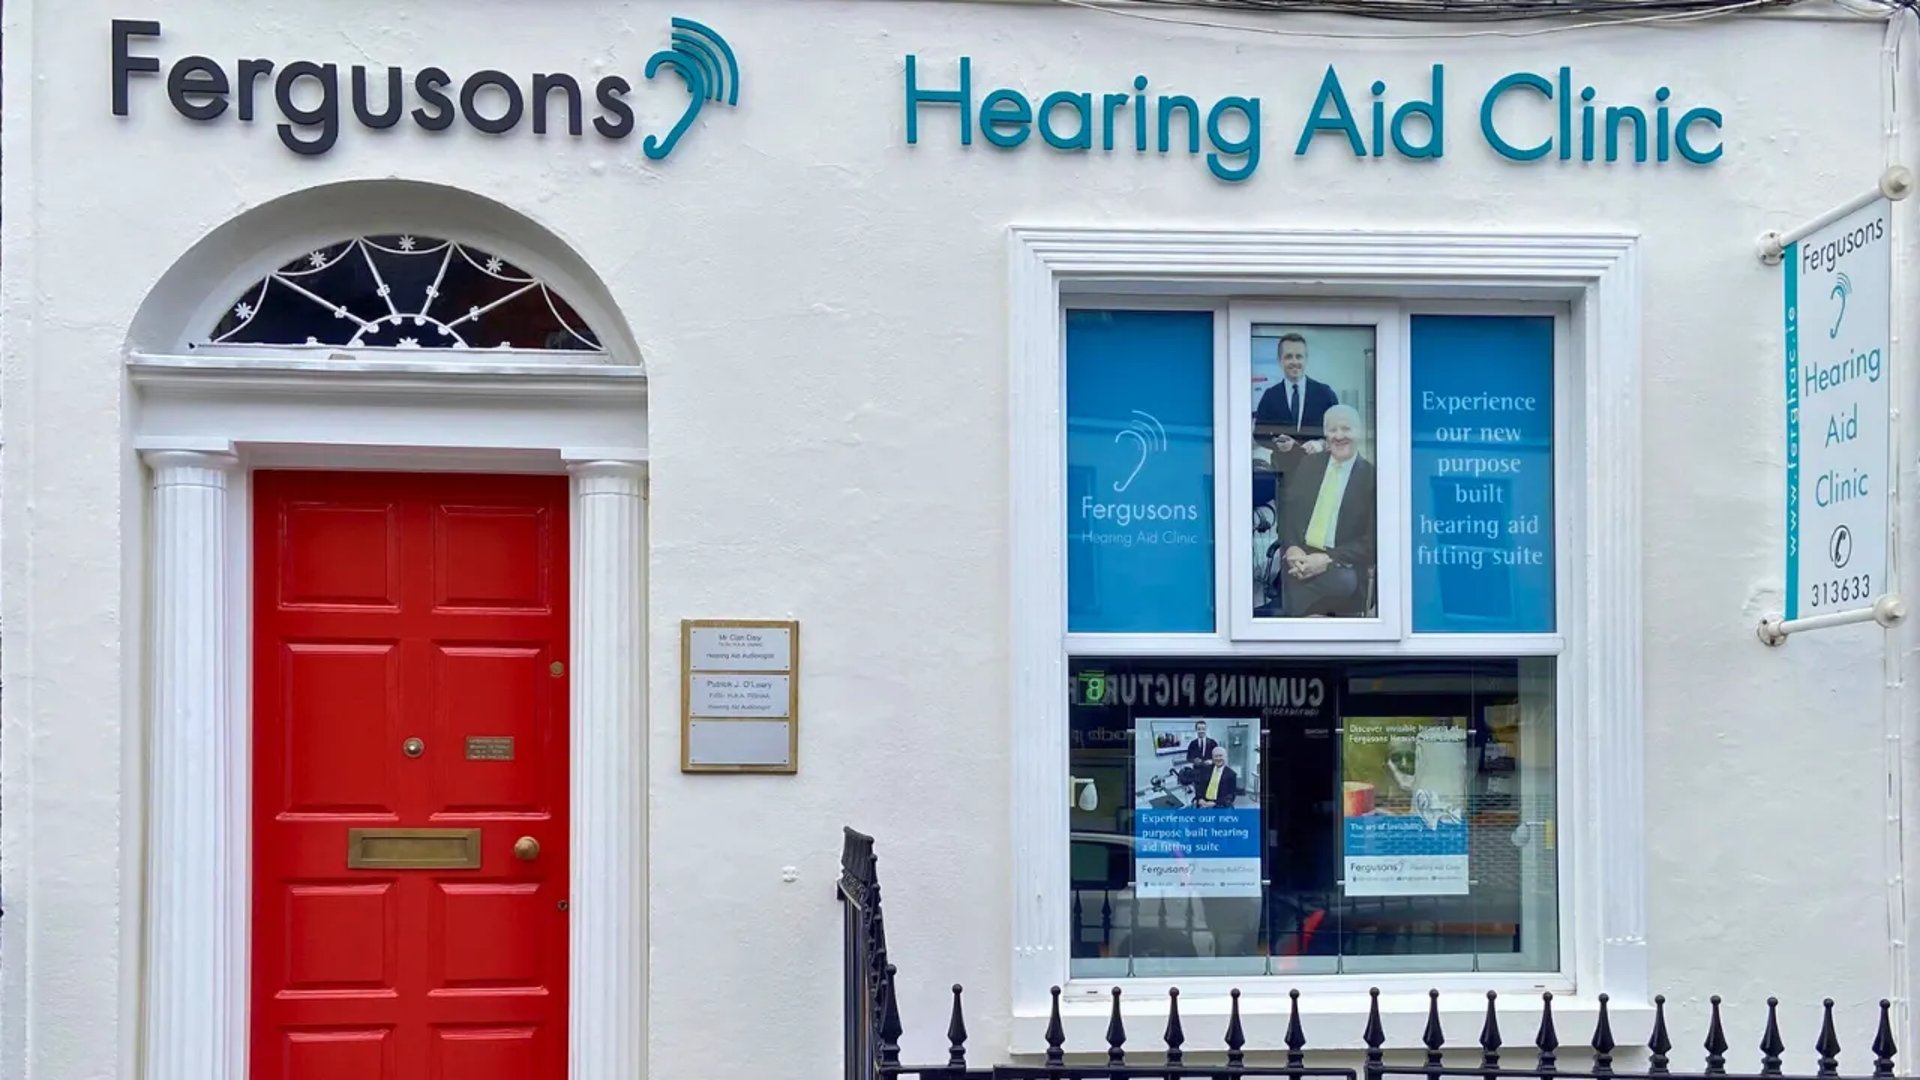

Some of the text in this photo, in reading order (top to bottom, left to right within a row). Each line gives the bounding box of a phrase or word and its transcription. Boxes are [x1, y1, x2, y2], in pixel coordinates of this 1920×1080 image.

[111, 19, 635, 155] Fergusons
[904, 54, 1724, 182] Hearing Aid Clinic
[1802, 217, 1884, 275] Fergusons
[1805, 348, 1881, 397] Hearing
[1421, 391, 1536, 415] Experience
[1435, 426, 1522, 442] our new
[1825, 402, 1858, 448] Aid
[1437, 457, 1522, 478] purpose
[1455, 483, 1505, 504] built
[1815, 468, 1869, 508] Clinic
[1081, 495, 1198, 527] Fergusons
[1081, 529, 1198, 547] Hearing Aid Clinic
[1419, 514, 1539, 540] hearing aid
[1417, 545, 1543, 571] fitting suite
[1810, 574, 1871, 608] 313633
[1349, 724, 1383, 733] Discover
[1142, 813, 1239, 826] Experience our new
[1142, 828, 1249, 839] purpose built hearing
[1141, 841, 1220, 854] aid fitting suite
[1142, 864, 1189, 876] Fergusons
[1350, 863, 1398, 874] Fergusons
